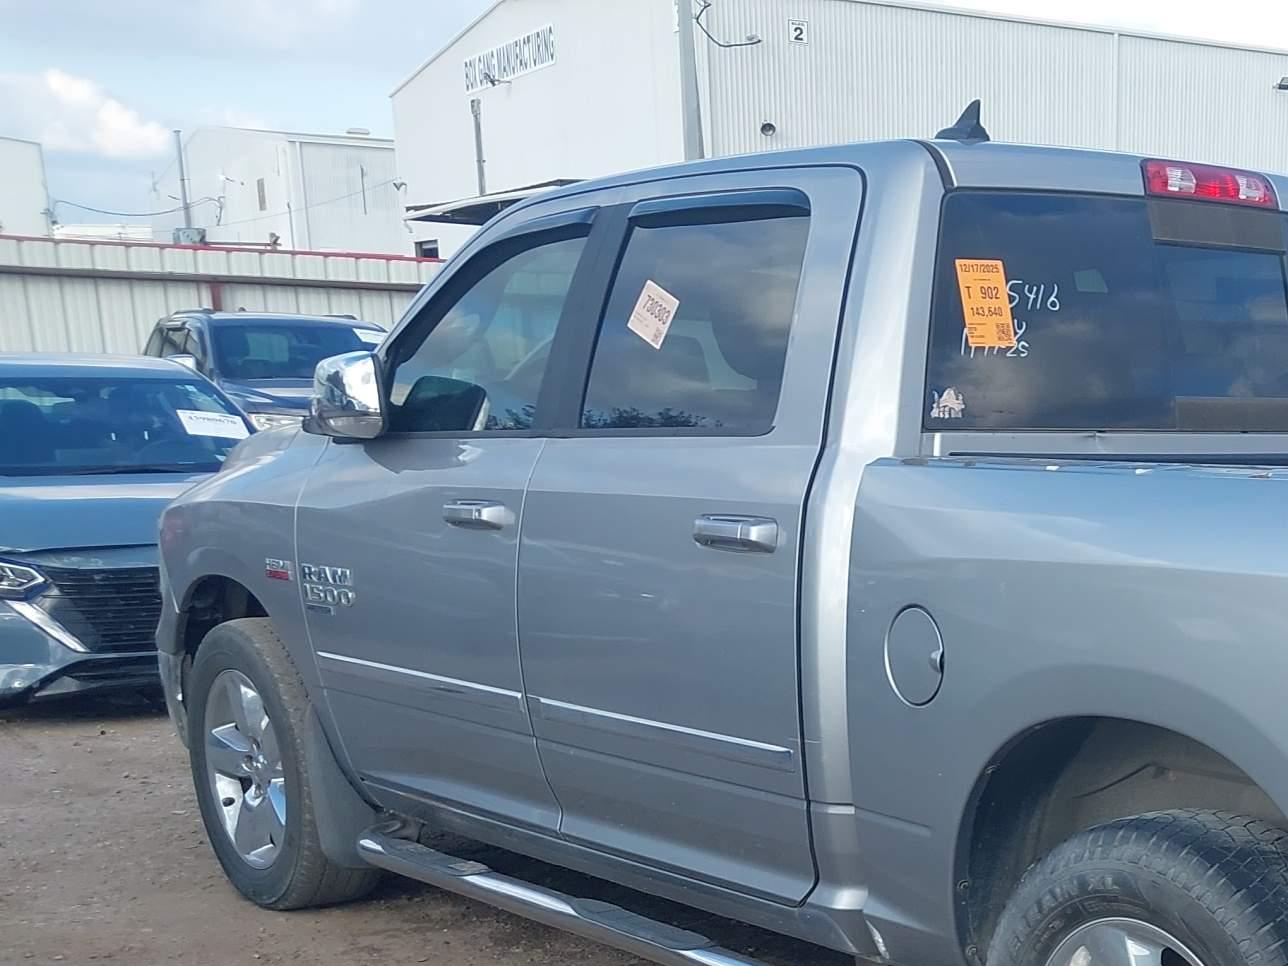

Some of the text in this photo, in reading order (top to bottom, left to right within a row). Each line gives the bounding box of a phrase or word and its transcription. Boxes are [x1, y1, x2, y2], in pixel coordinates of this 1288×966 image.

[793, 26, 804, 41] 2
[464, 58, 479, 91] BOX
[496, 25, 555, 79] MANUFACTURING
[959, 263, 1000, 273] 12/17/2025
[964, 286, 1001, 299] T 902
[301, 562, 352, 586] RAM
[303, 583, 355, 607] 1500
